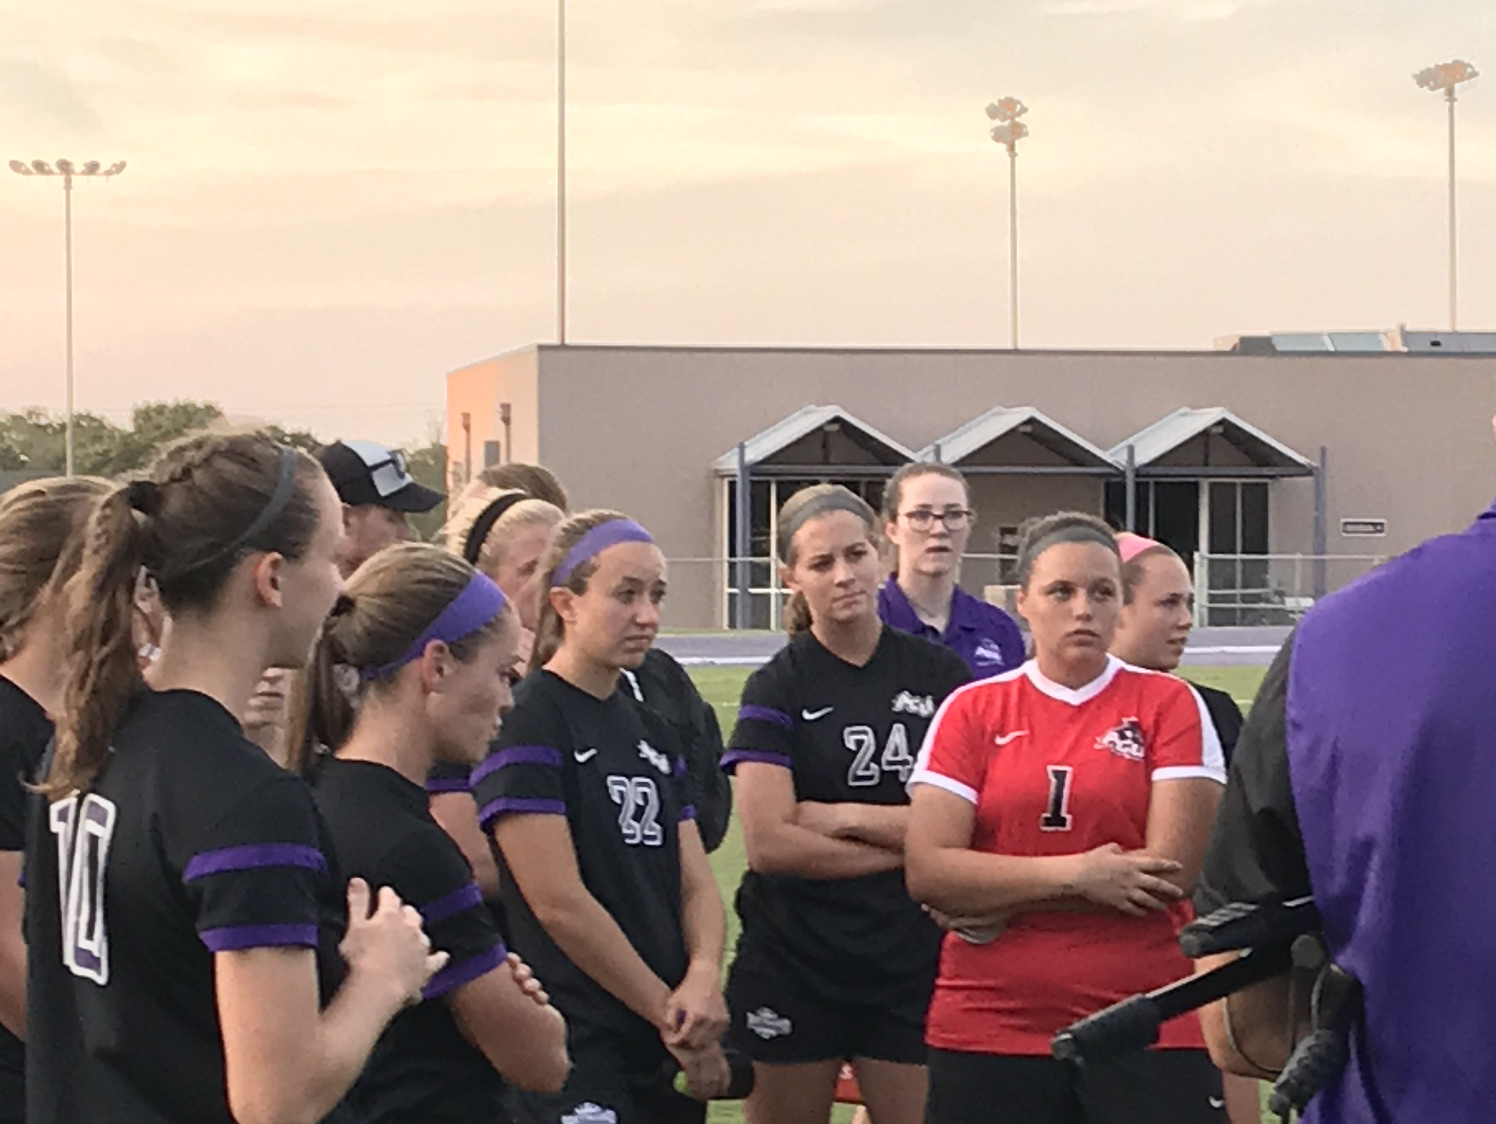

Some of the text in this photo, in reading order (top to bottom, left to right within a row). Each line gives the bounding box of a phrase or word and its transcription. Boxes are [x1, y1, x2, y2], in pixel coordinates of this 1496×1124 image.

[843, 723, 914, 786] 24
[606, 775, 663, 845] 22
[1040, 765, 1073, 832] 1
[49, 792, 116, 985] 10
